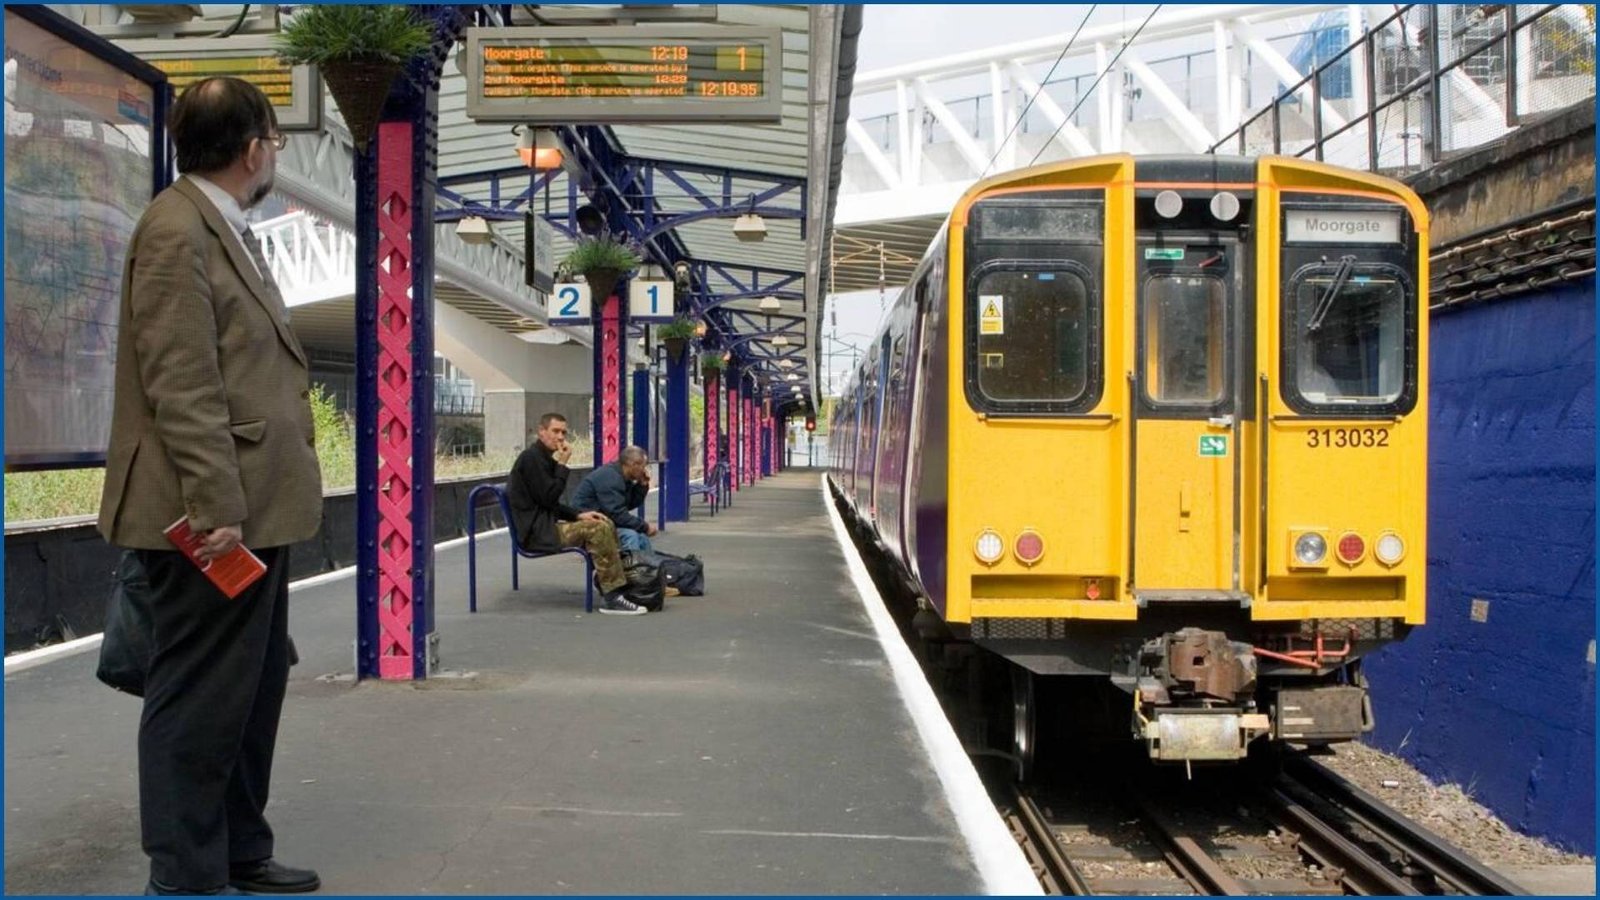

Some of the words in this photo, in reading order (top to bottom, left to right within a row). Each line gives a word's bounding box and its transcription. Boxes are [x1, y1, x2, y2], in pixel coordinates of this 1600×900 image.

[484, 47, 545, 61] Moorgate
[650, 46, 688, 61] 12:19
[736, 46, 746, 71] 1
[506, 75, 565, 85] Moorgate
[1305, 219, 1381, 234] Moorgate
[558, 287, 580, 316] 2
[647, 285, 658, 314] 1
[1307, 428, 1389, 448] 313032
